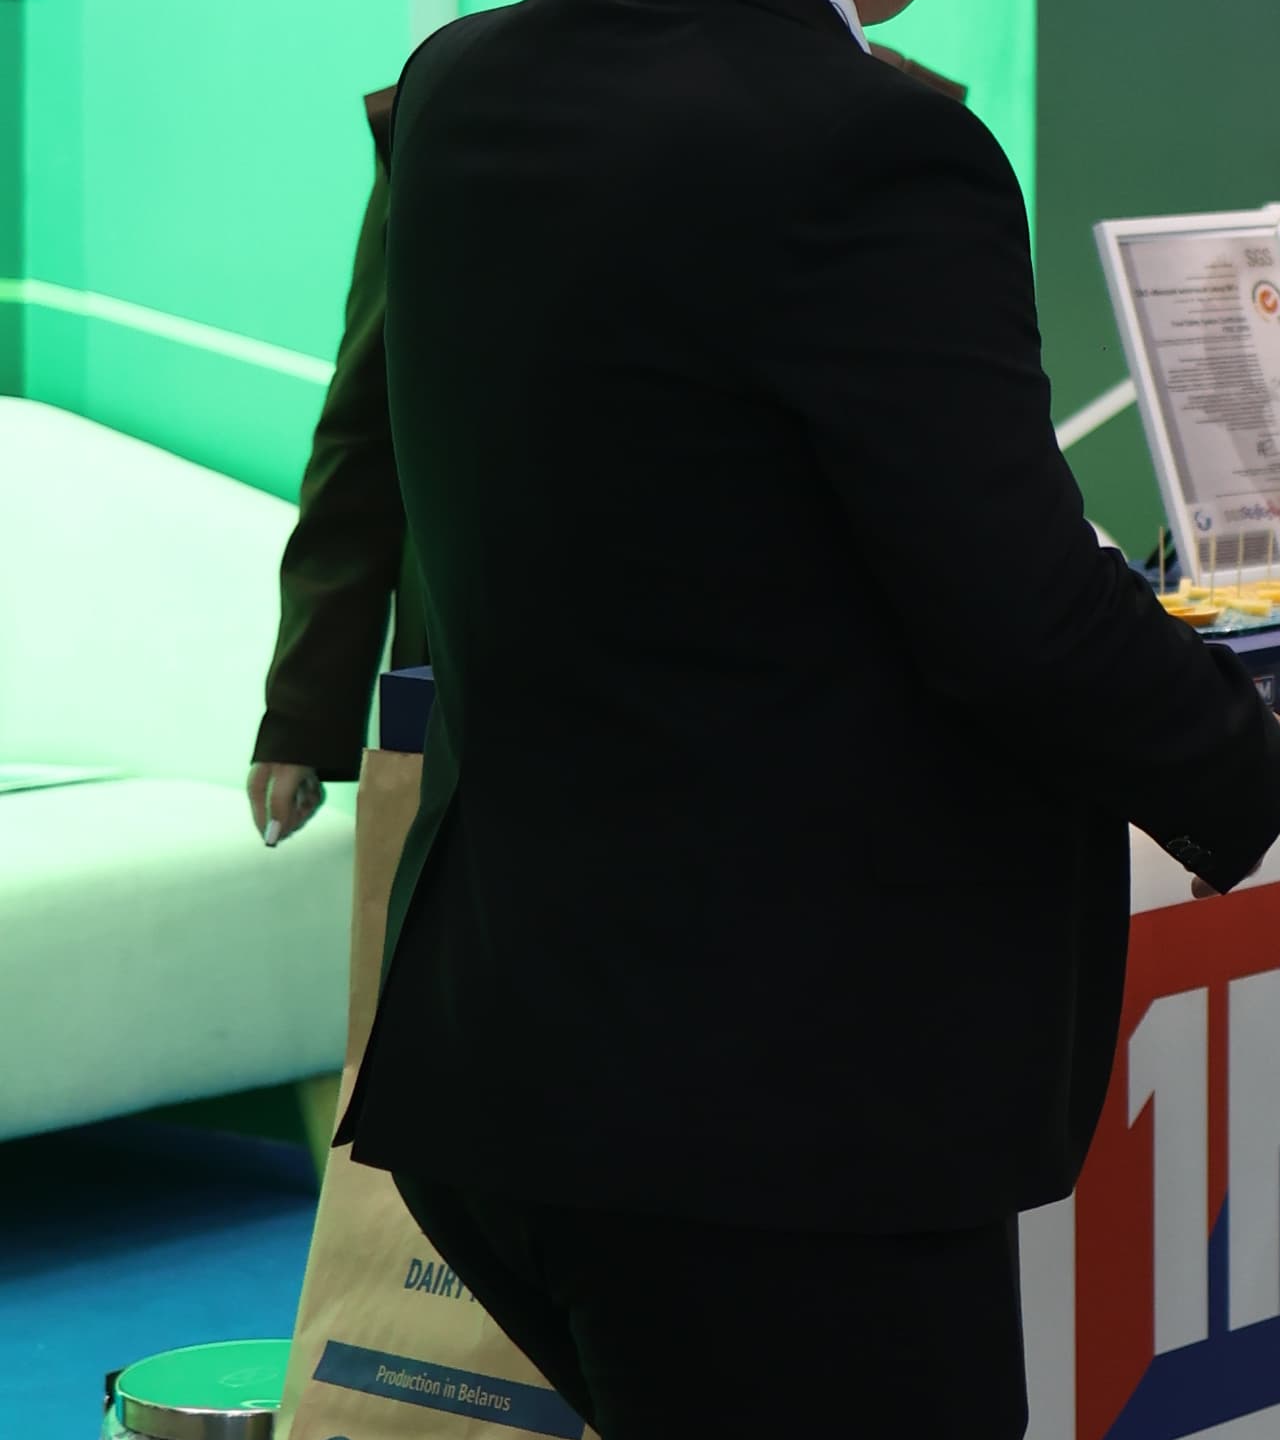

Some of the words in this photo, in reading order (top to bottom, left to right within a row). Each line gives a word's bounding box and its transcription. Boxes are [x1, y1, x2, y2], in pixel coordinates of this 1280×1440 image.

[1244, 247, 1274, 268] SGS
[404, 1257, 465, 1300] DAIRY
[376, 1365, 440, 1395] Production
[443, 1378, 455, 1399] in
[458, 1383, 512, 1412] Belarus
